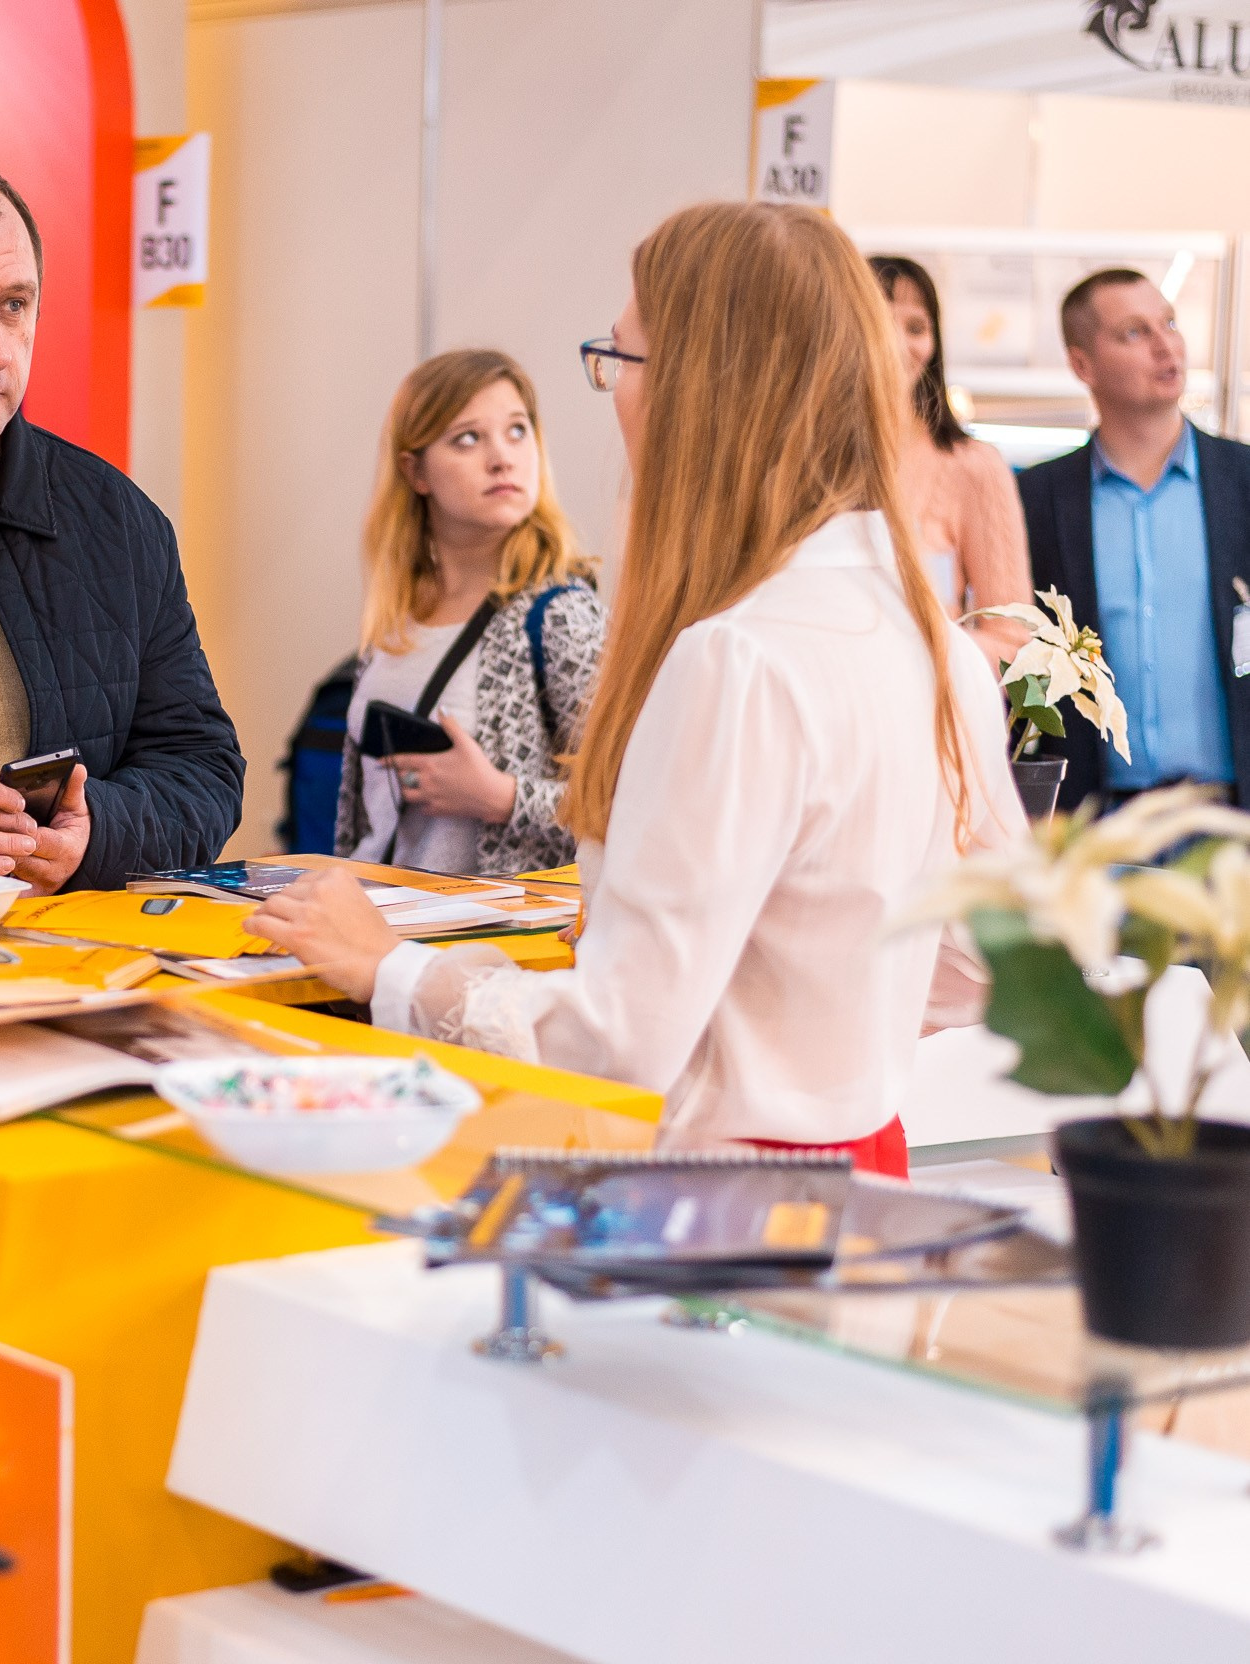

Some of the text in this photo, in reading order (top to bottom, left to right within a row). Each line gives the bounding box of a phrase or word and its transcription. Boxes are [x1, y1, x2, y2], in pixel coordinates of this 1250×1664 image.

[783, 115, 804, 157] F
[764, 165, 823, 198] A30
[157, 178, 176, 226] F
[141, 234, 192, 271] B30
